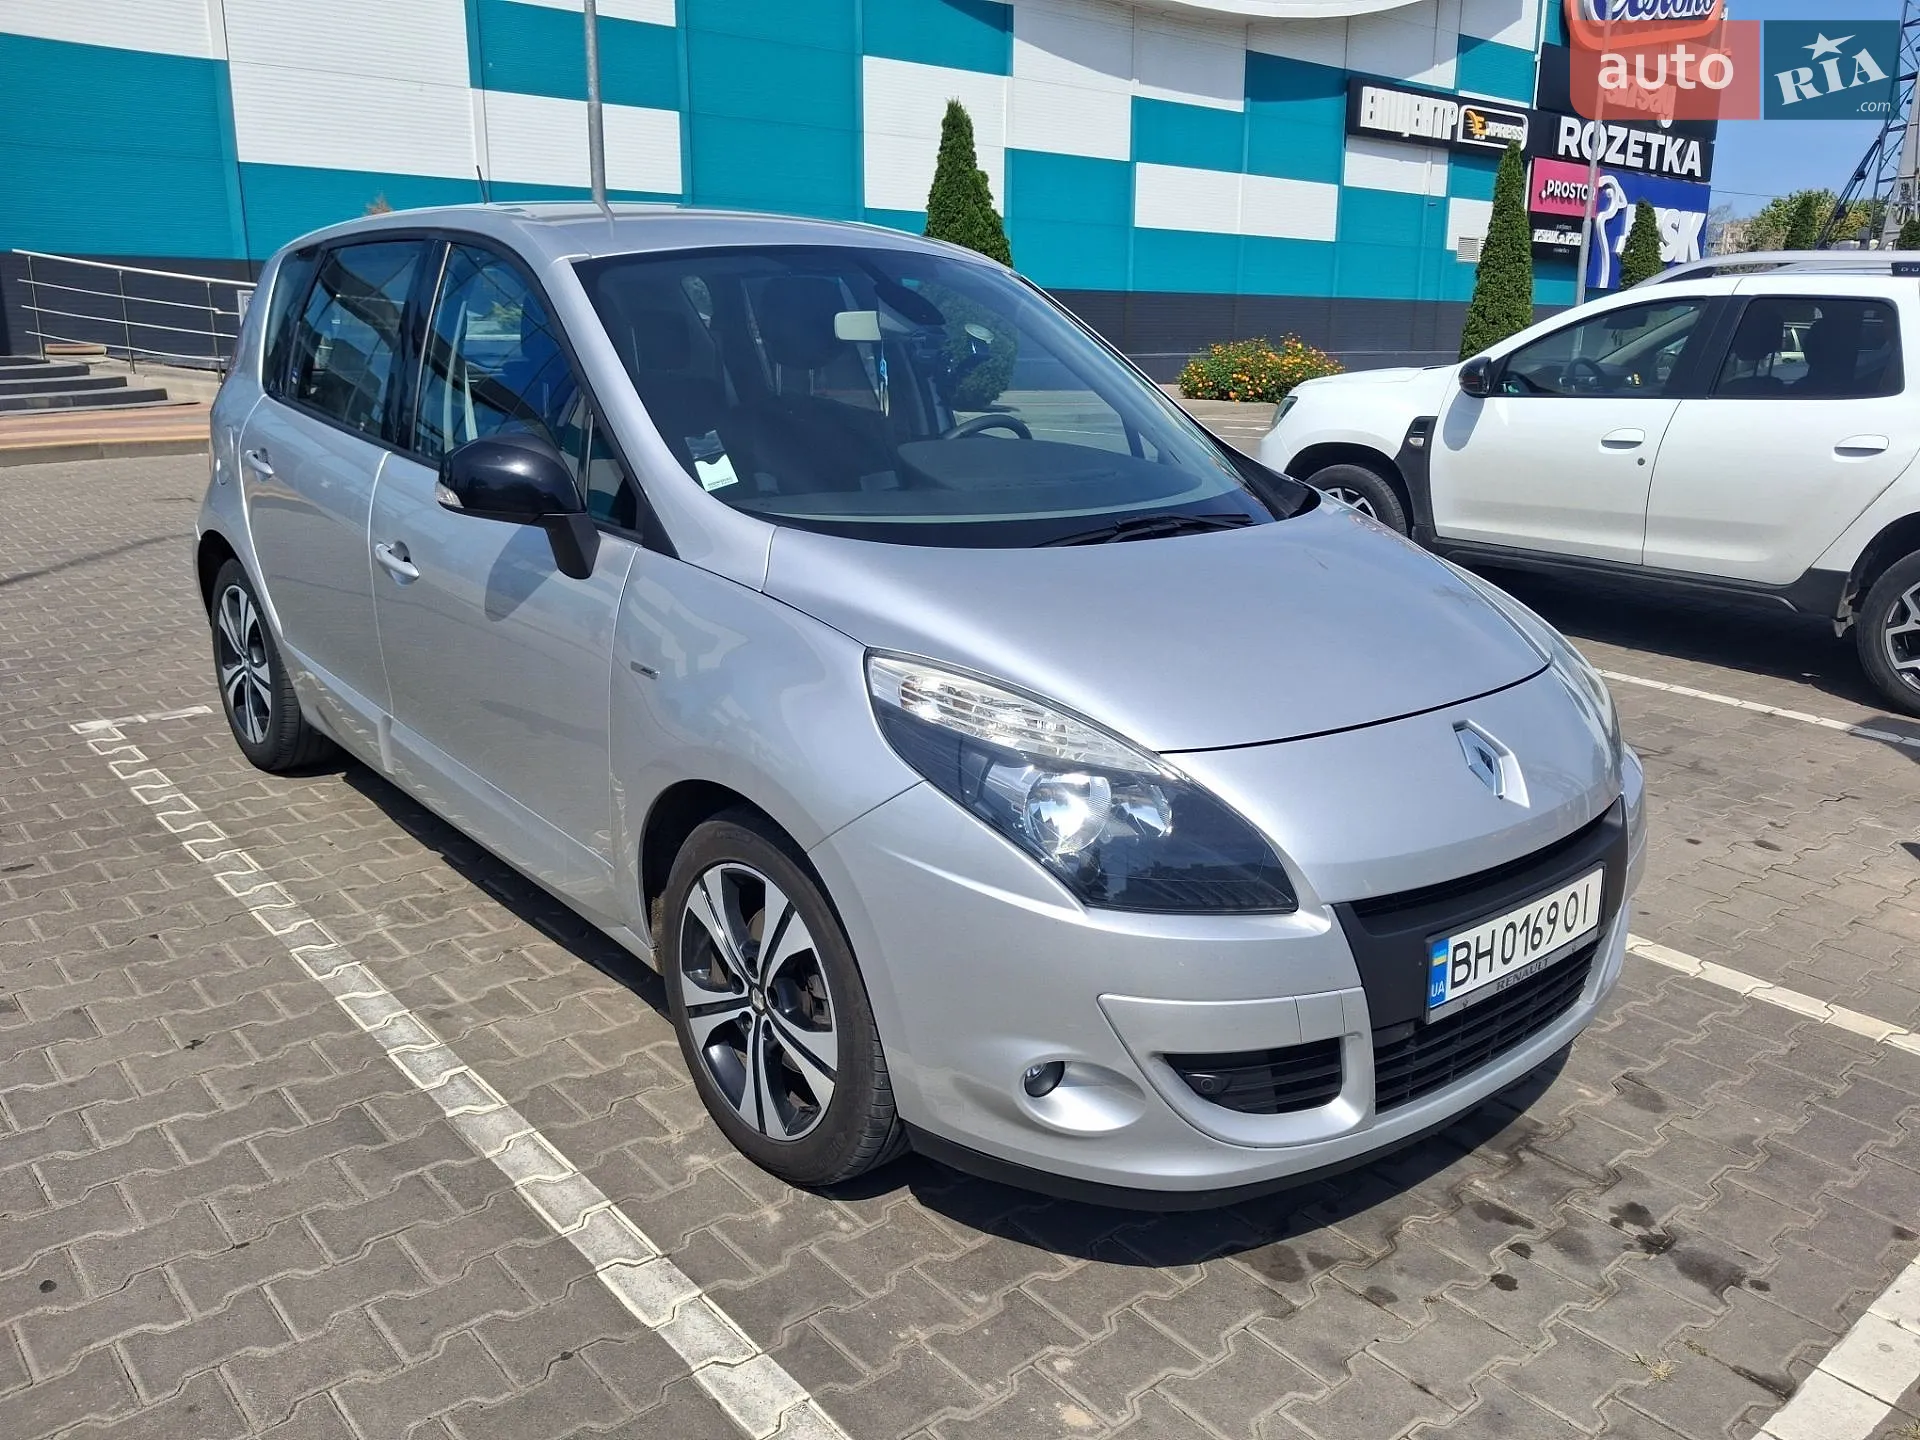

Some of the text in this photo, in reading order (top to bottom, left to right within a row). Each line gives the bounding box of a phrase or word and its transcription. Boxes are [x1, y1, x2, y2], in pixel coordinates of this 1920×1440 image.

[1558, 116, 1702, 177] ROZETKA
[1431, 981, 1446, 997] UA
[1496, 957, 1551, 992] RENAULT
